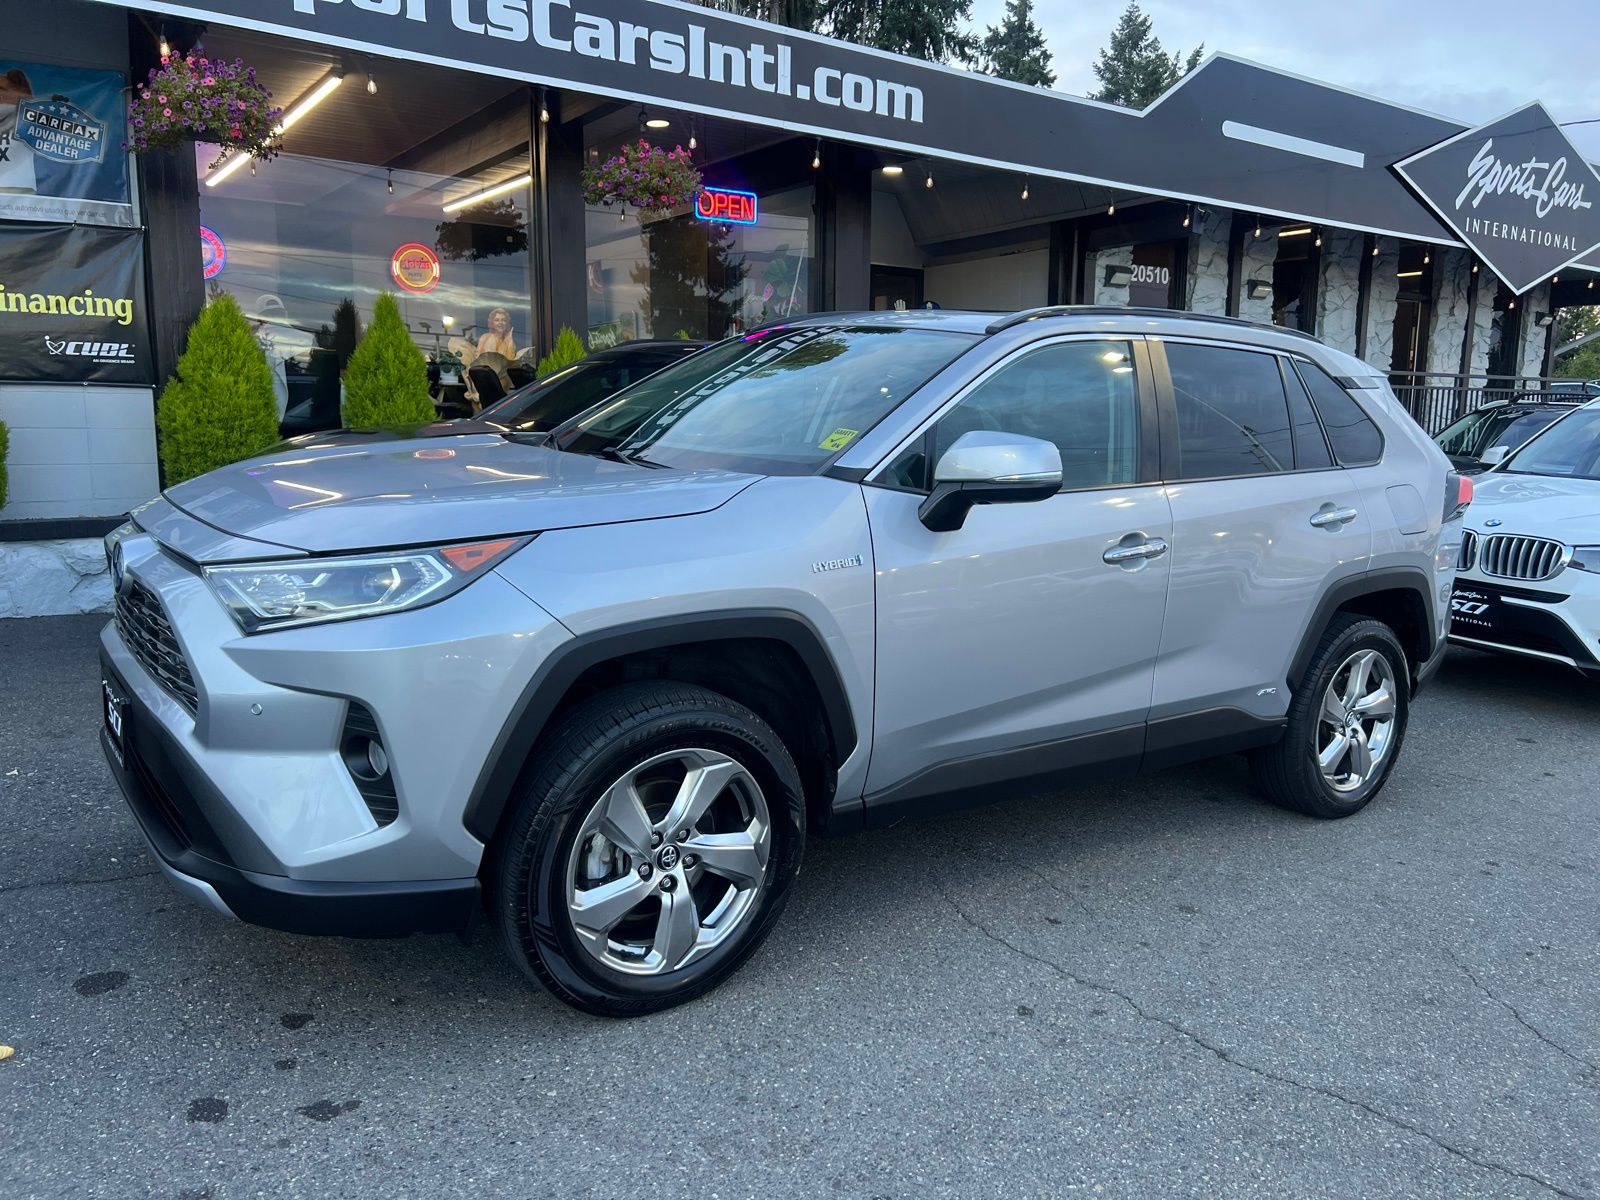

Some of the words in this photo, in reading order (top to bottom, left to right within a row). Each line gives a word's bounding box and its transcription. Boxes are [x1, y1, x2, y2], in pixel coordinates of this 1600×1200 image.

[293, 0, 924, 123] rtsCarsIntl.com
[25, 109, 97, 140] CARFAX
[27, 125, 92, 151] ADVANTAGE
[35, 140, 79, 159] DEALER
[1455, 138, 1549, 212] Sports
[1535, 156, 1592, 219] Cars
[699, 191, 754, 221] OPEN
[1465, 217, 1577, 251] INTERNATIONAL
[1131, 264, 1169, 284] 20510
[0, 284, 133, 325] inancing
[66, 341, 135, 357] CUDL
[812, 556, 859, 573] HYBRID
